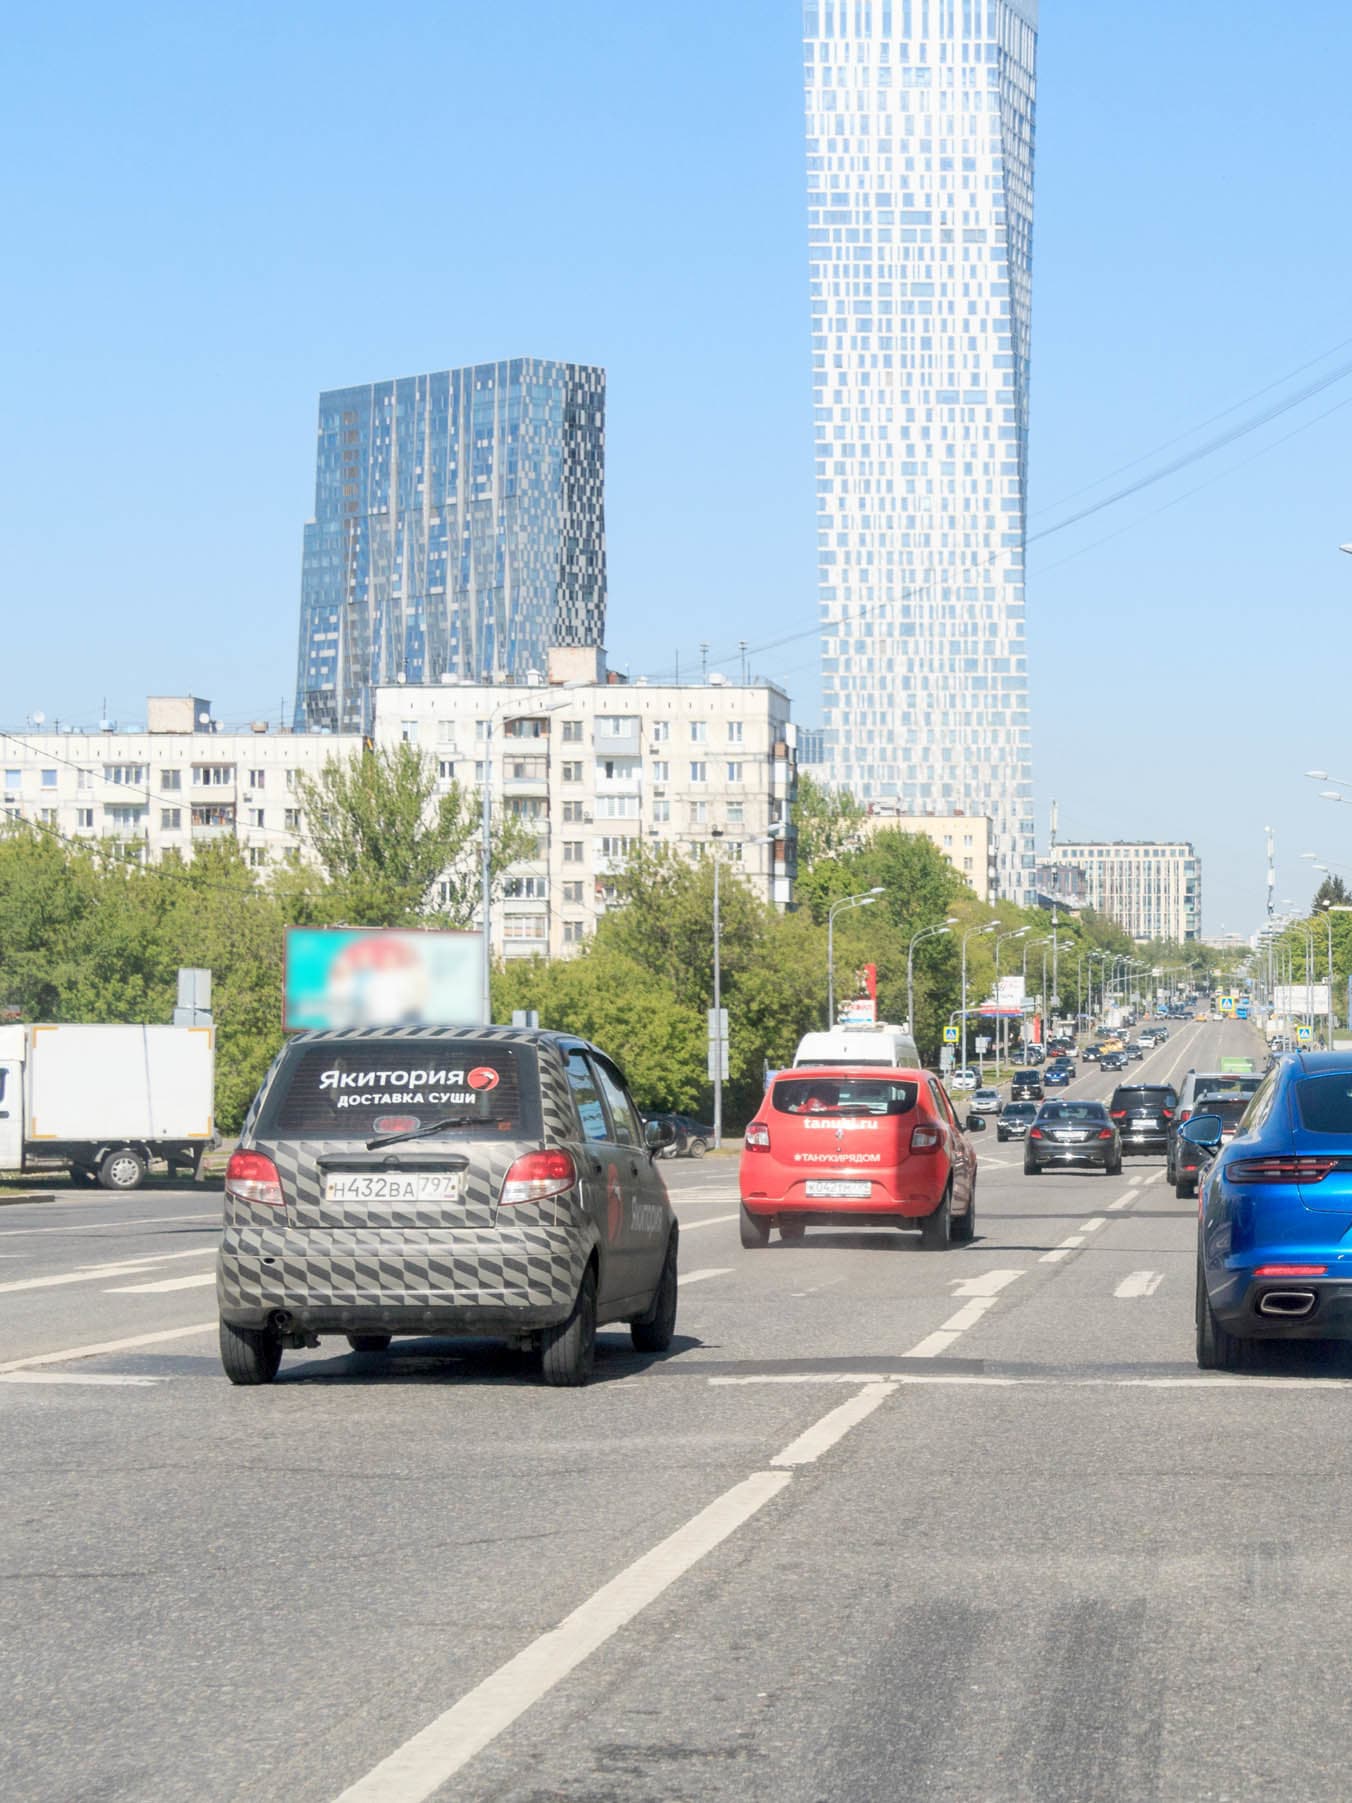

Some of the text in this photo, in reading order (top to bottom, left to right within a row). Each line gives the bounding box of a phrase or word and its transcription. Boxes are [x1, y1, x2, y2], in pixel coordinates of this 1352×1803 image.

[319, 1070, 464, 1089] Якитория
[337, 1092, 476, 1108] ДОСТАВКА СУШИ
